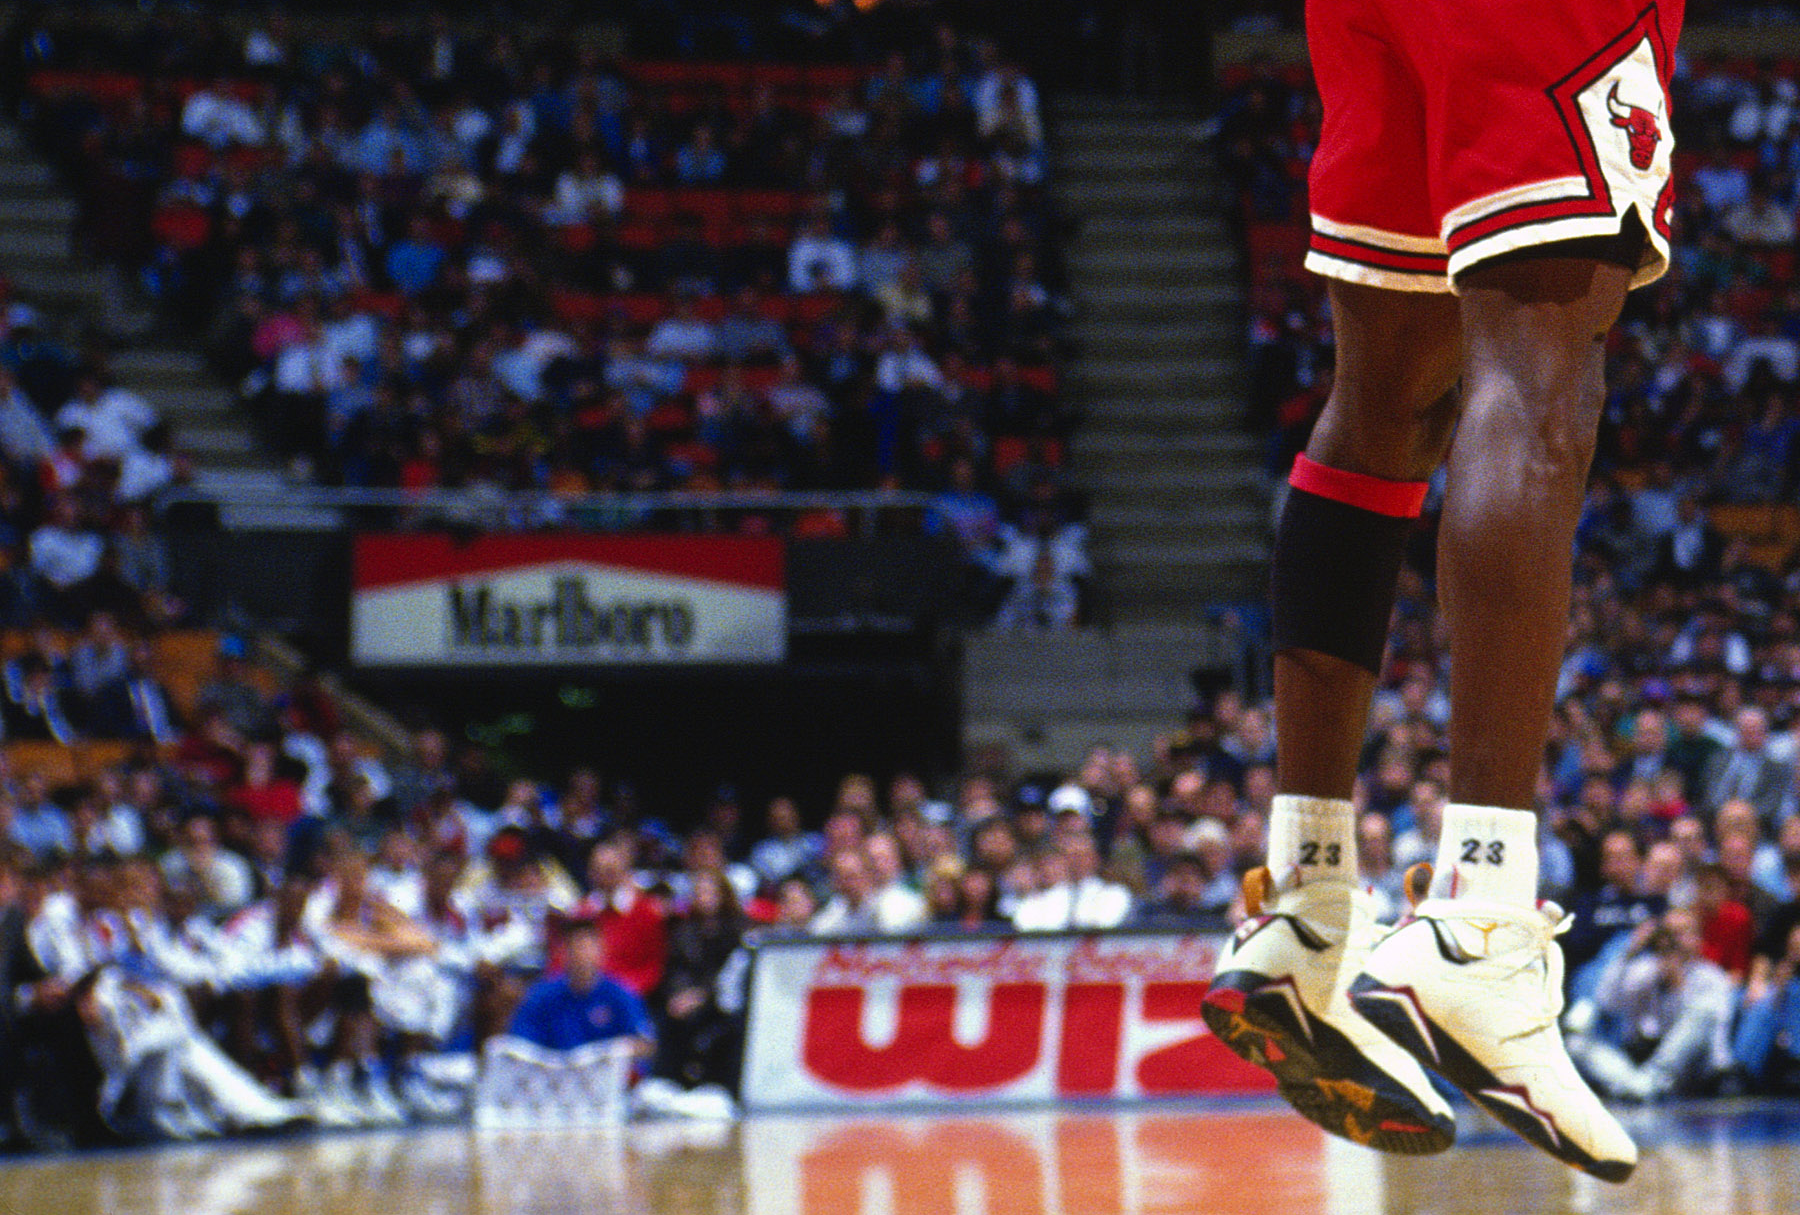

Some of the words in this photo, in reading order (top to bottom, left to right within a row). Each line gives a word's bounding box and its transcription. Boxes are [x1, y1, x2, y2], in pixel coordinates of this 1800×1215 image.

[449, 577, 696, 648] Marlboro
[1300, 841, 1341, 867] 23
[1461, 838, 1506, 866] 23
